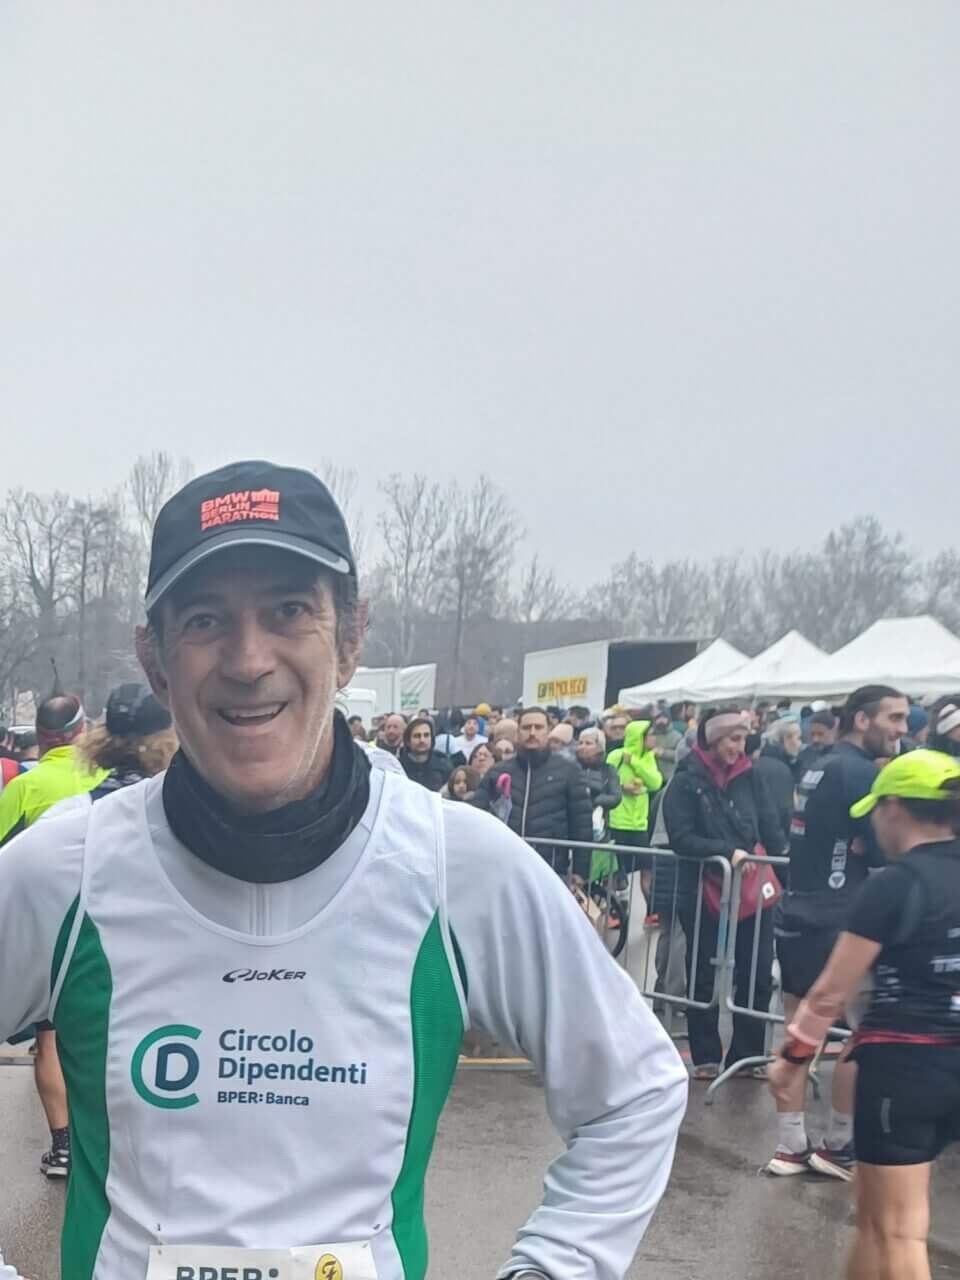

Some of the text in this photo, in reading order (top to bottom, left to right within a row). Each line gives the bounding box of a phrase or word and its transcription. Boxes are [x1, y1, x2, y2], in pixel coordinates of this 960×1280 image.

[201, 491, 251, 512] BMW
[201, 501, 251, 522] BERLIN
[201, 511, 280, 531] MARATHON
[218, 1029, 314, 1053] Circolo
[218, 1057, 367, 1085] Dipendenti
